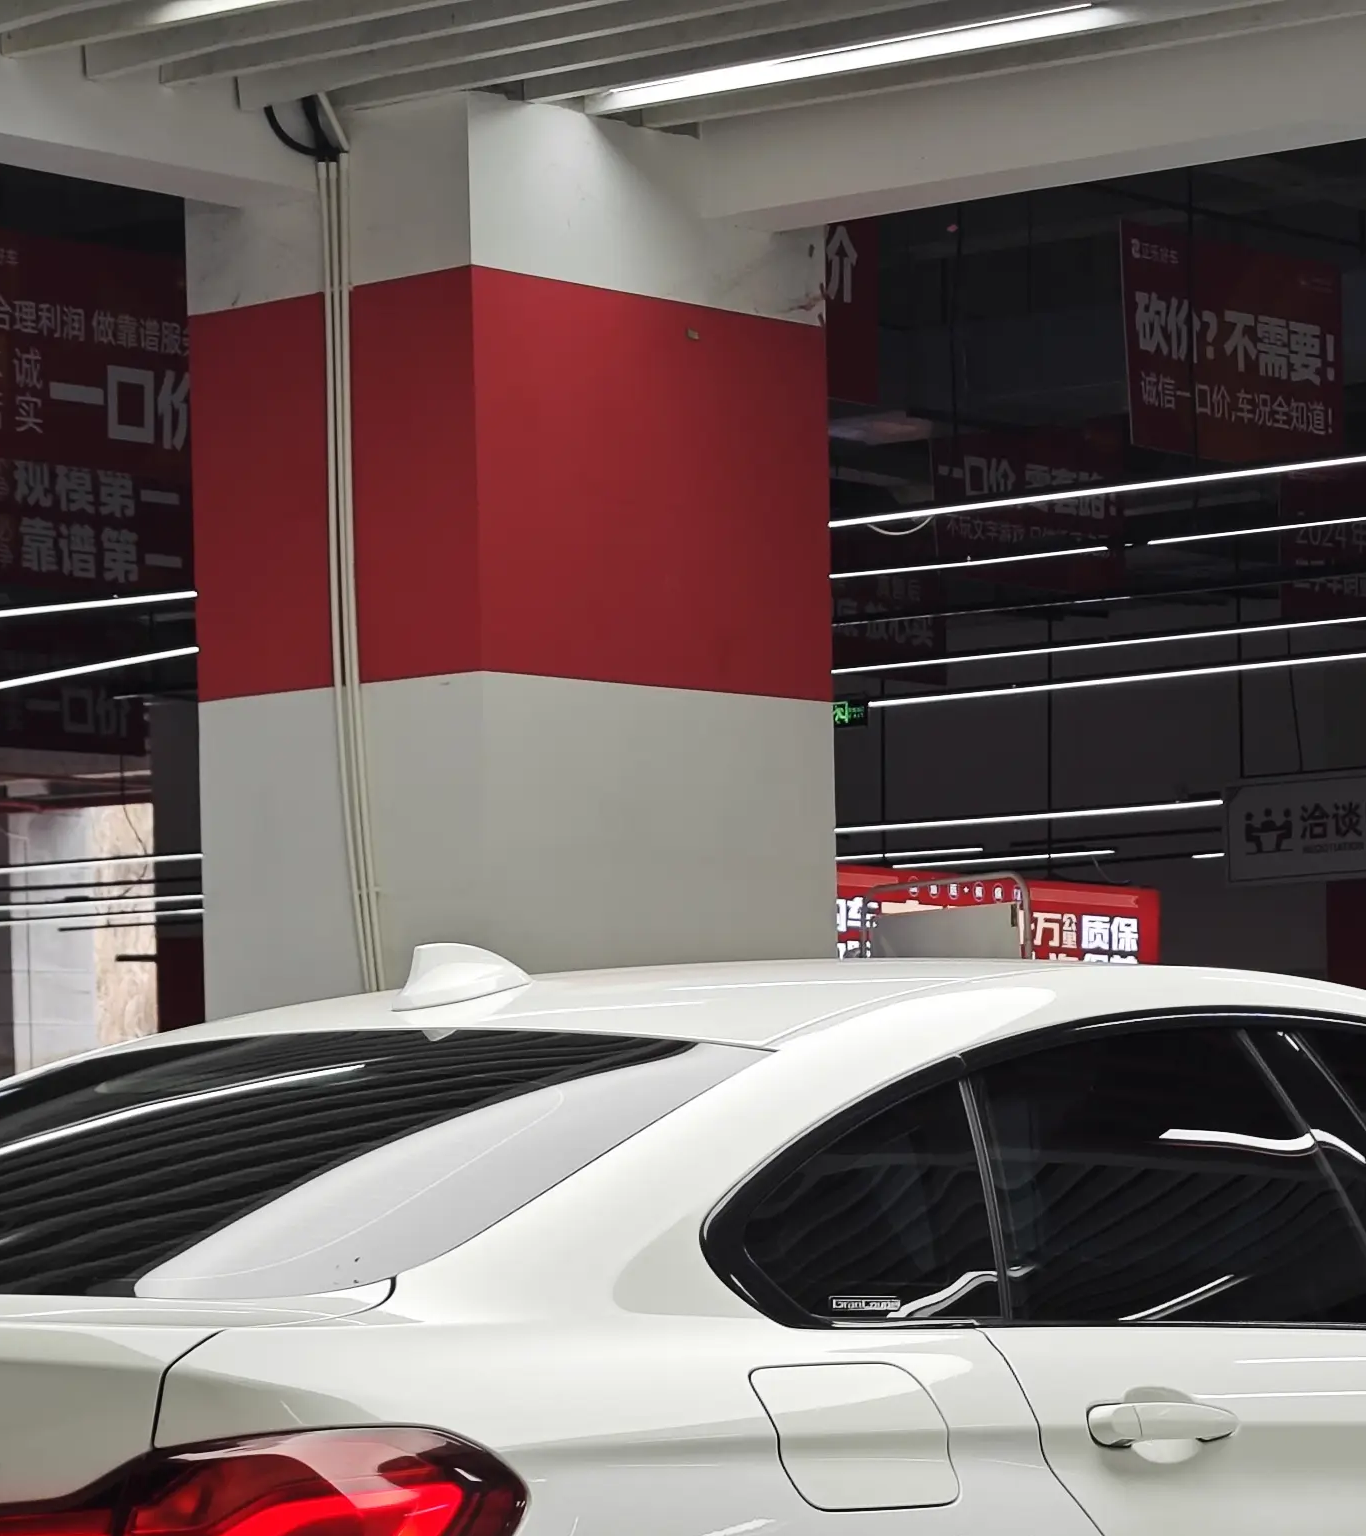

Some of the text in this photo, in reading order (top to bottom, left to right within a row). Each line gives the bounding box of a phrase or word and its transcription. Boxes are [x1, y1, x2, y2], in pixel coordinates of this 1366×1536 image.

[1134, 290, 1336, 388] 砍价?不需要!
[1140, 369, 1334, 437] 诚信一口价,车况全知道!
[12, 459, 181, 518] 规模第一
[18, 516, 183, 586] 靠谱第一
